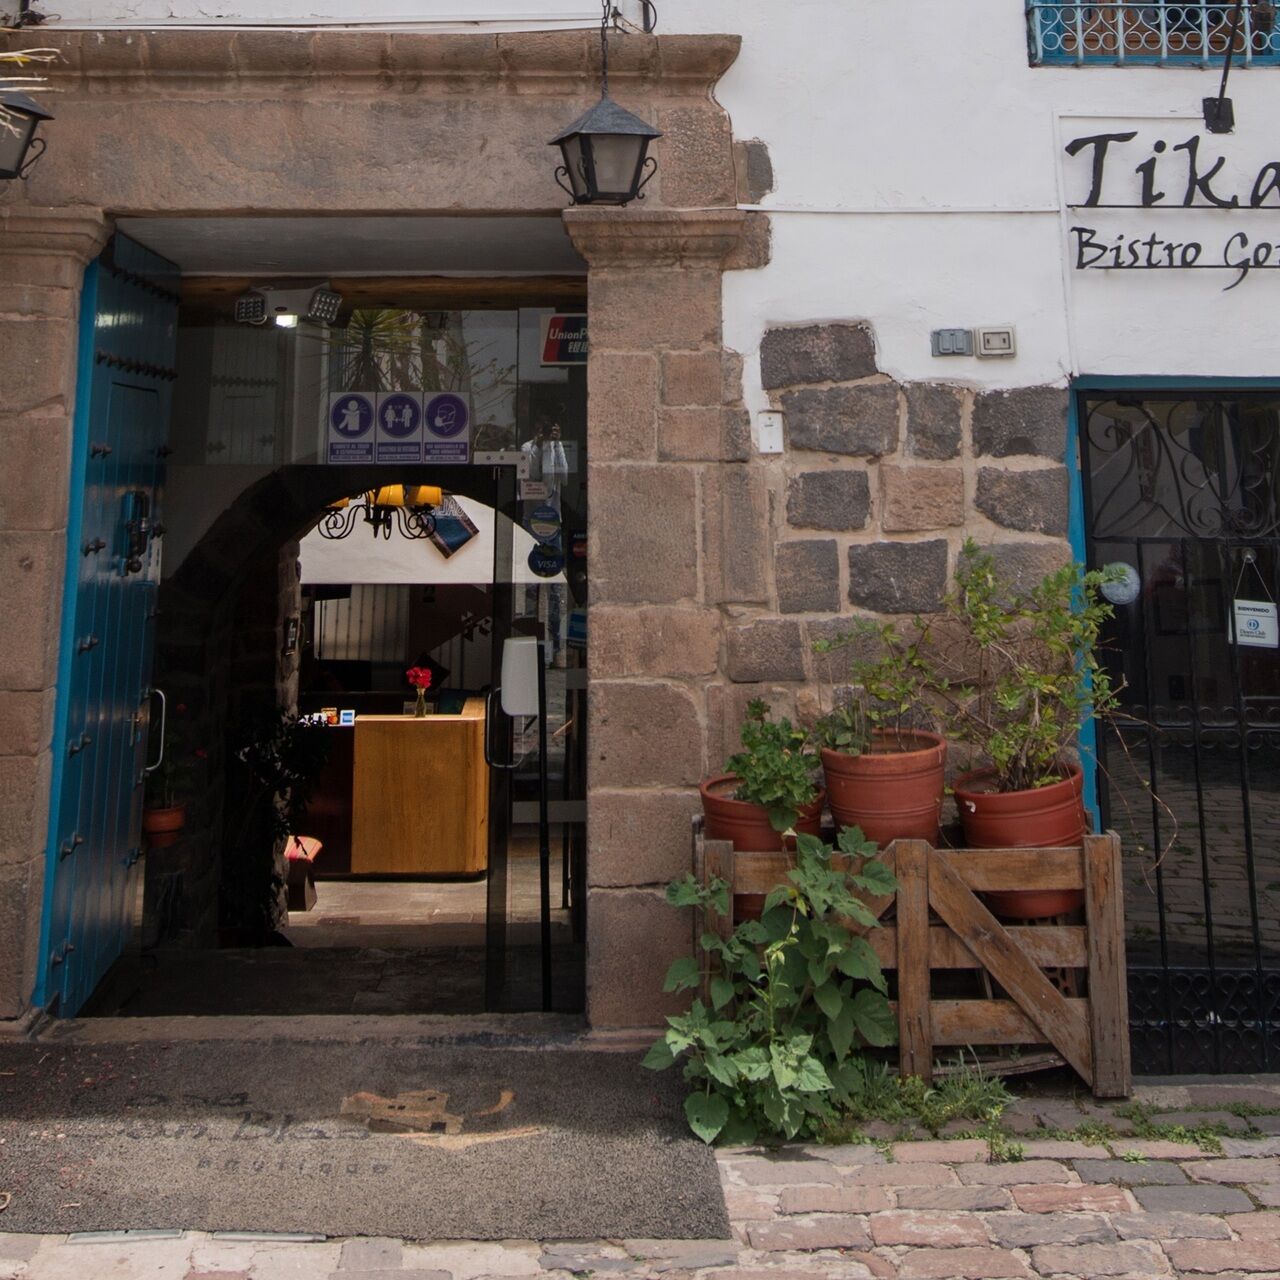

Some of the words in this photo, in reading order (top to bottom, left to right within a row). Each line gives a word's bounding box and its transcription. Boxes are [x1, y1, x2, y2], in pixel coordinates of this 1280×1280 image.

[1070, 226, 1203, 270] Bistro
[549, 327, 588, 340] UnionP
[537, 560, 558, 569] VISA
